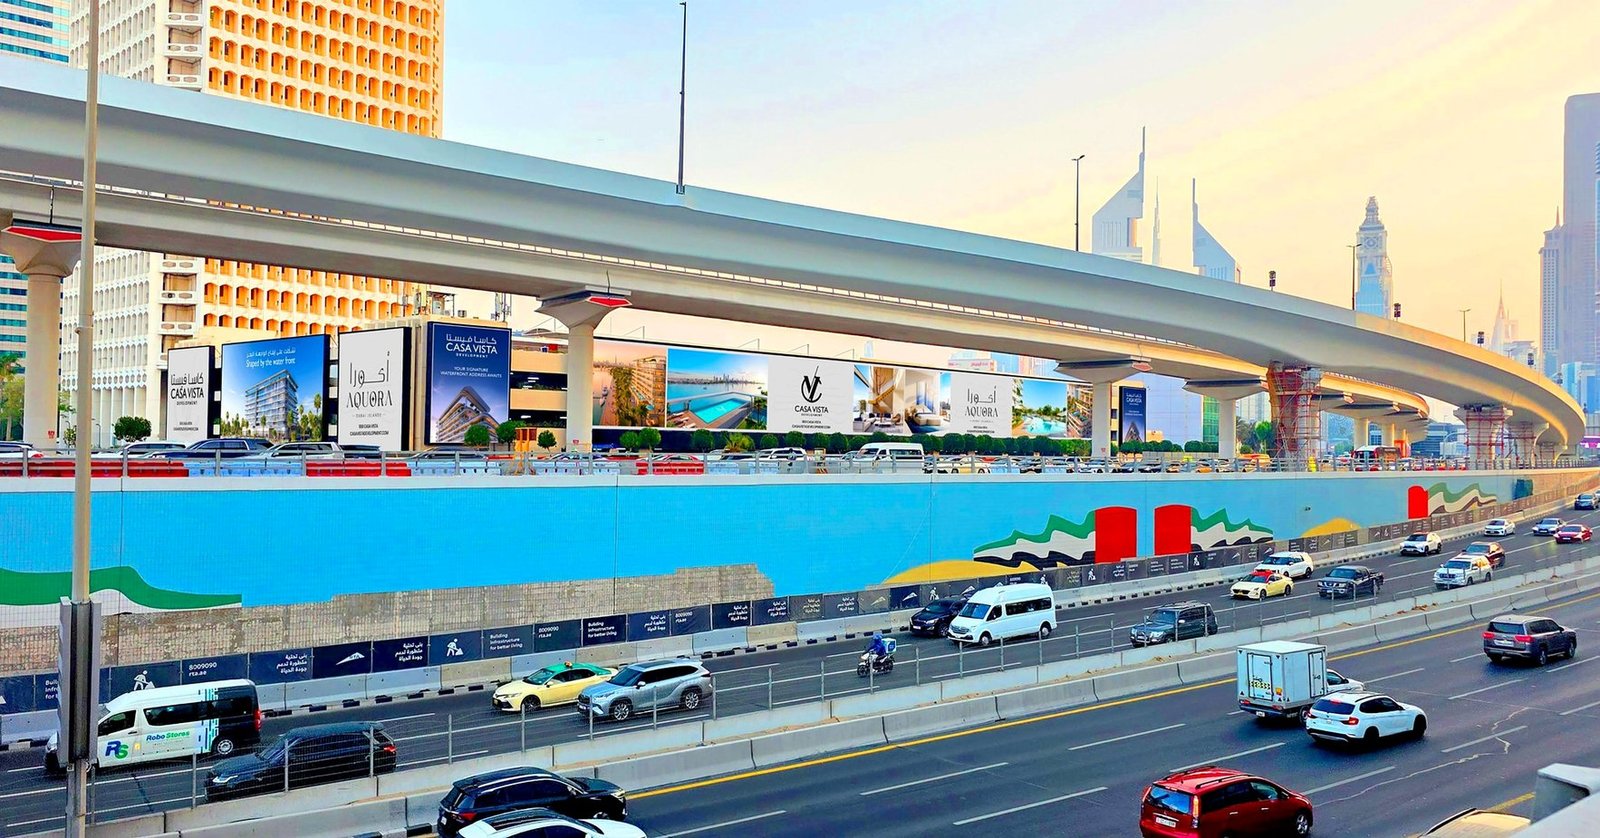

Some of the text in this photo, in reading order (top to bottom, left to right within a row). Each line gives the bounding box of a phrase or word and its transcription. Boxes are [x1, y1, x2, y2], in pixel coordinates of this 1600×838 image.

[446, 333, 497, 345] كاسا فيستا
[445, 342, 498, 354] CASA VISTA
[245, 356, 296, 369] Shaped by the water front
[349, 350, 391, 390] أكورا
[170, 372, 204, 386] كاسا فيستا
[170, 387, 204, 400] CASA VISTA
[346, 389, 393, 410] AQUORA
[794, 405, 829, 414] CASA VISTA
[964, 406, 999, 418] AQUORA
[188, 662, 218, 671] 8009090
[145, 731, 190, 742] Robo Stores
[105, 740, 129, 760] RS
